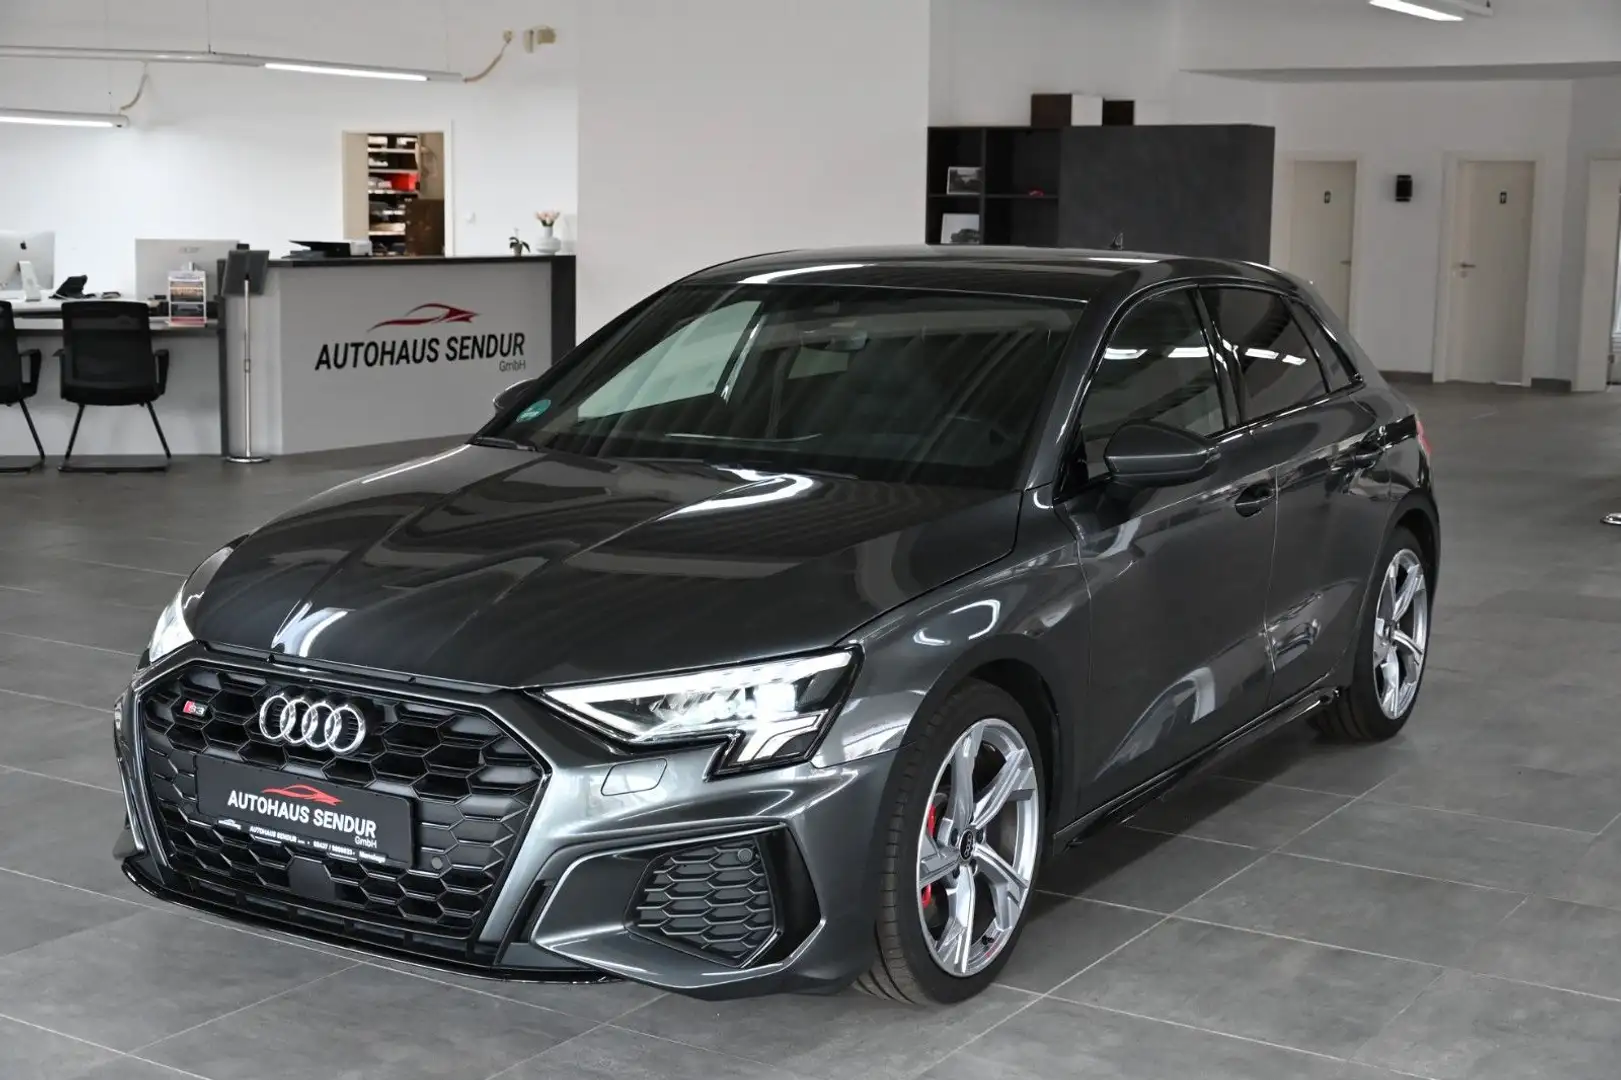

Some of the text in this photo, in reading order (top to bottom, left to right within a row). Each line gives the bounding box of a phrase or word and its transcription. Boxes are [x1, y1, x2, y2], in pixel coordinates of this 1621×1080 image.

[315, 332, 525, 371] AUTOHAUS SENDUR
[499, 359, 526, 372] GmbH
[228, 790, 377, 838] AUTOHAUS SENDUR
[354, 836, 378, 849] GmbH
